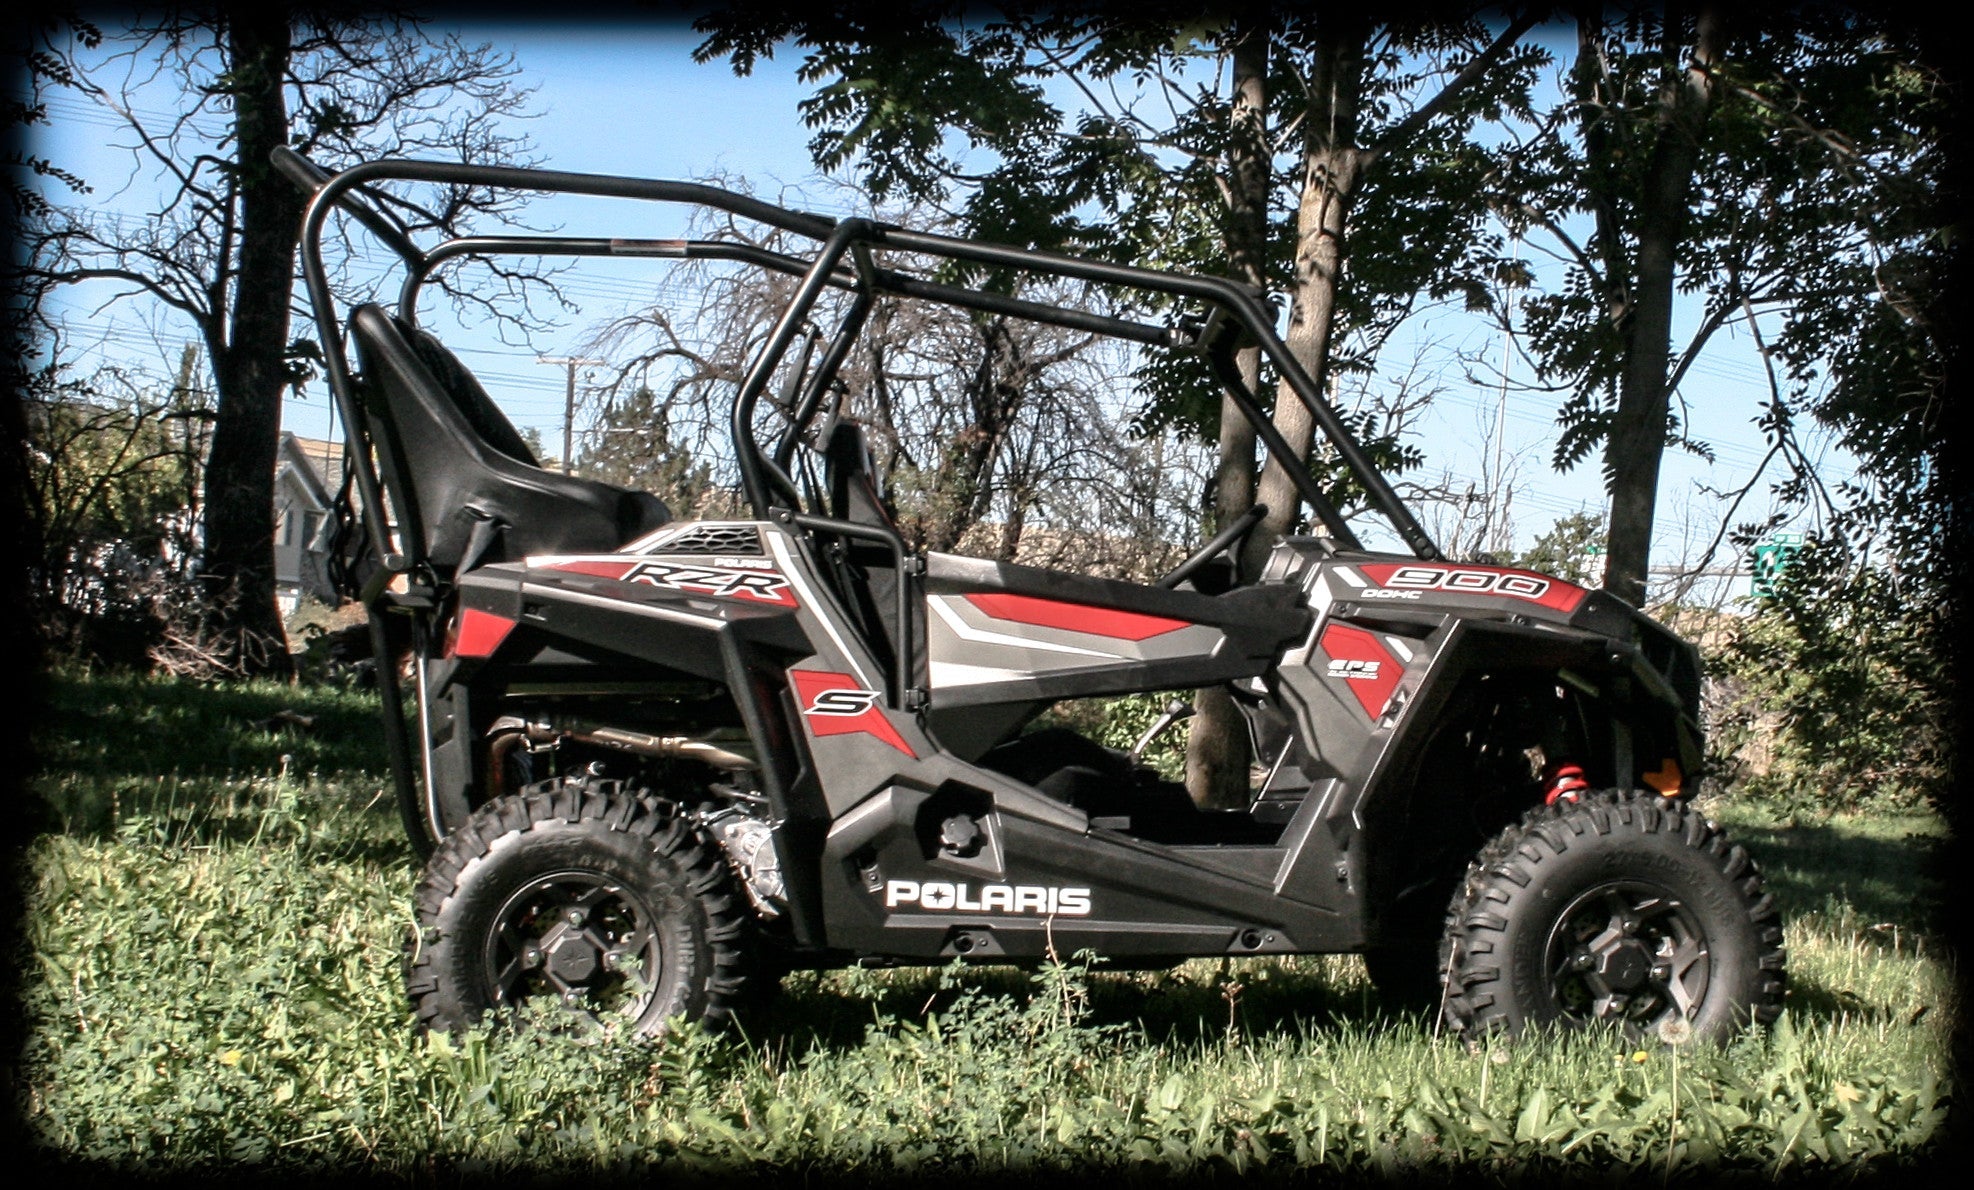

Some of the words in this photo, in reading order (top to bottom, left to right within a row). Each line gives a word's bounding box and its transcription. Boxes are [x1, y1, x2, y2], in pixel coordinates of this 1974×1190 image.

[714, 558, 773, 569] POLARIS
[619, 561, 791, 600] RZR
[1385, 566, 1550, 599] 900
[1360, 589, 1423, 600] DOHC
[1327, 659, 1381, 672] EPS
[803, 689, 881, 716] S
[886, 880, 1091, 915] POLARIS
